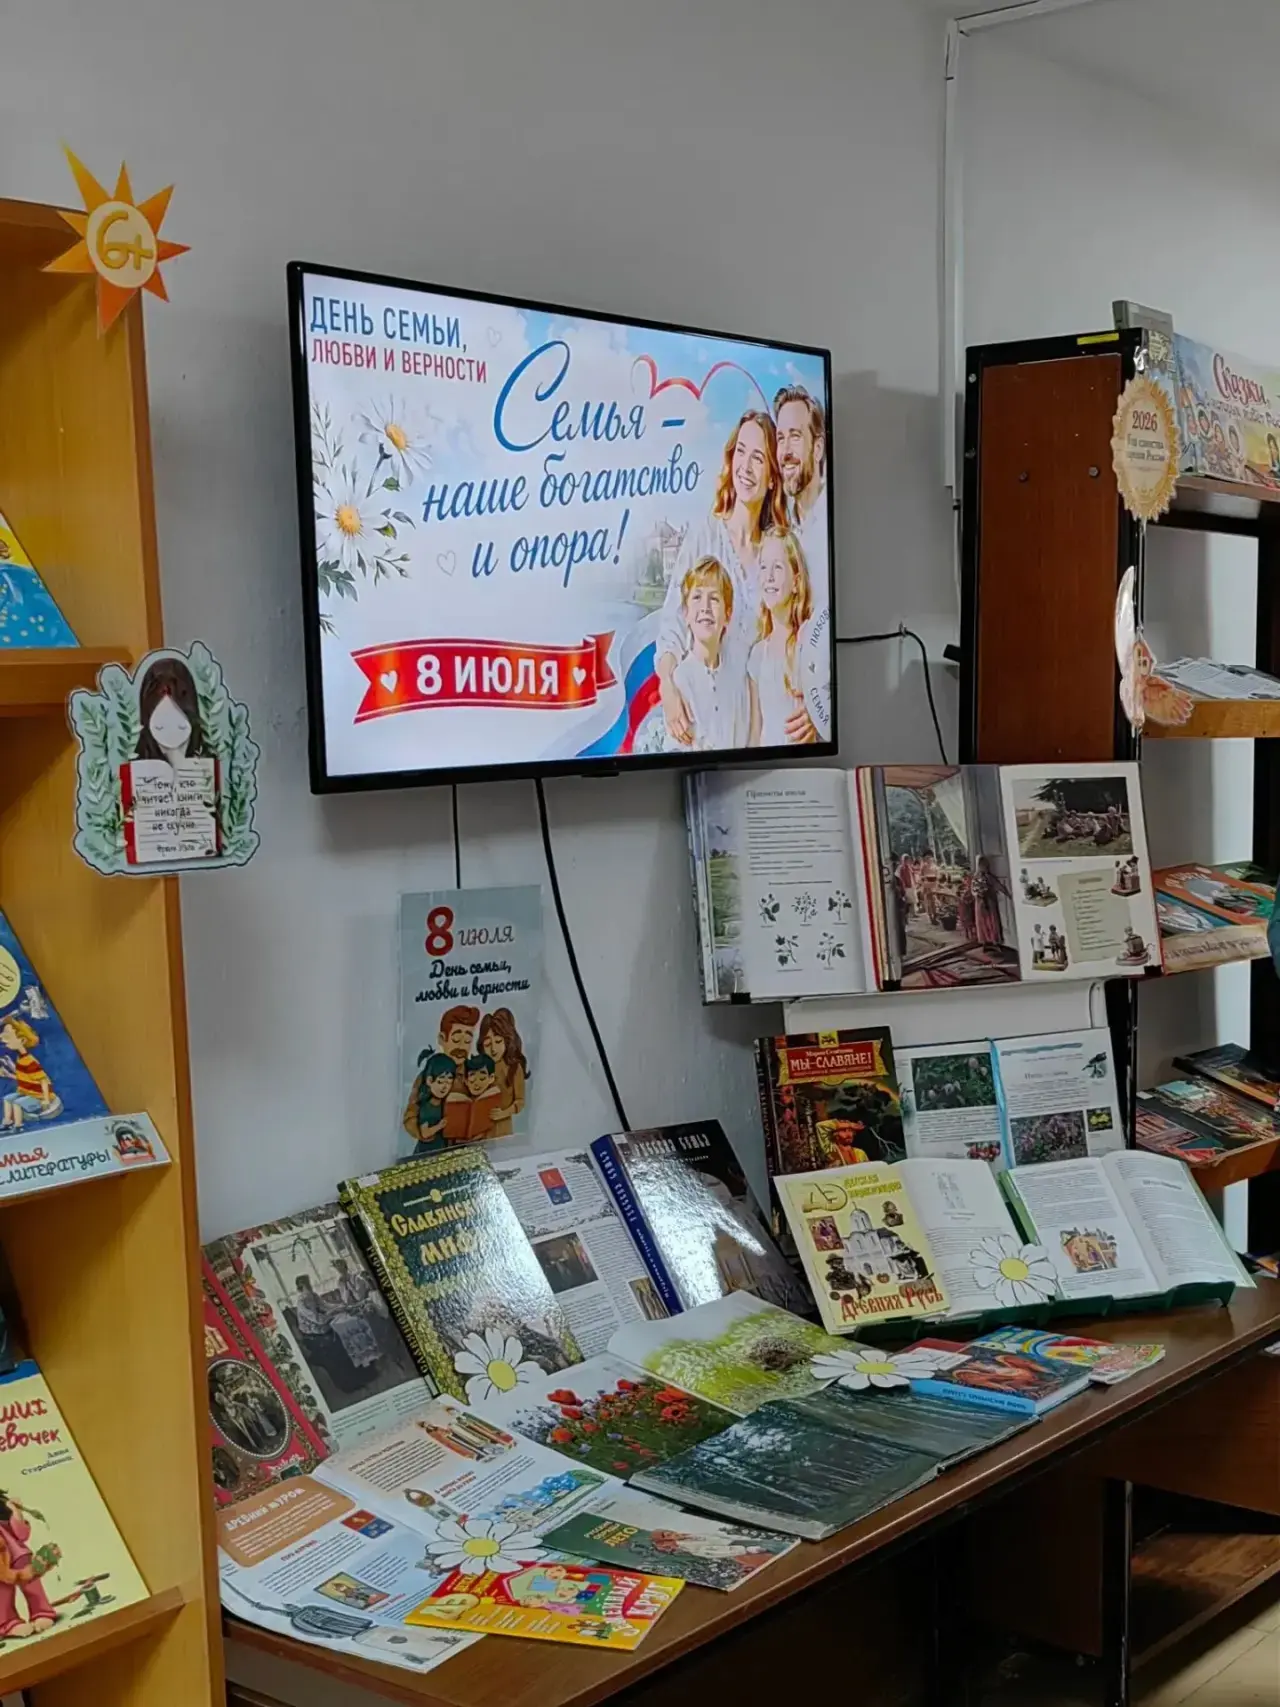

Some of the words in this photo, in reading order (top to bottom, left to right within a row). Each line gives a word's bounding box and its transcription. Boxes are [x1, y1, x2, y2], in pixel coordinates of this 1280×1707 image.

[97, 211, 153, 270] 6+
[310, 296, 374, 336] ДЕНЬ
[383, 307, 467, 350] СЕМЬИ,
[311, 339, 376, 369] ЛЮБВИ
[384, 347, 395, 372] И
[402, 349, 487, 384] ВЕРНОСТИ
[493, 340, 646, 452] Семья
[1131, 410, 1158, 433] 2026
[421, 470, 530, 523] наше
[539, 443, 704, 502] богатство
[472, 541, 499, 577] и
[510, 510, 631, 588] опора!
[415, 653, 443, 696] 8
[455, 657, 560, 695] ИЮЛЯ
[810, 687, 830, 726] СЕМЬЯ
[152, 823, 164, 831] не
[425, 906, 454, 956] 8
[458, 925, 515, 946] июля
[415, 979, 459, 1002] любви
[461, 985, 470, 997] и
[471, 975, 531, 1004] верности
[429, 959, 468, 979] День
[469, 960, 512, 974] семьи,
[0, 1147, 49, 1167] мья
[420, 1223, 478, 1266] МИФ
[0, 1422, 61, 1453] евочек
[603, 1527, 639, 1547] ЛЕТО
